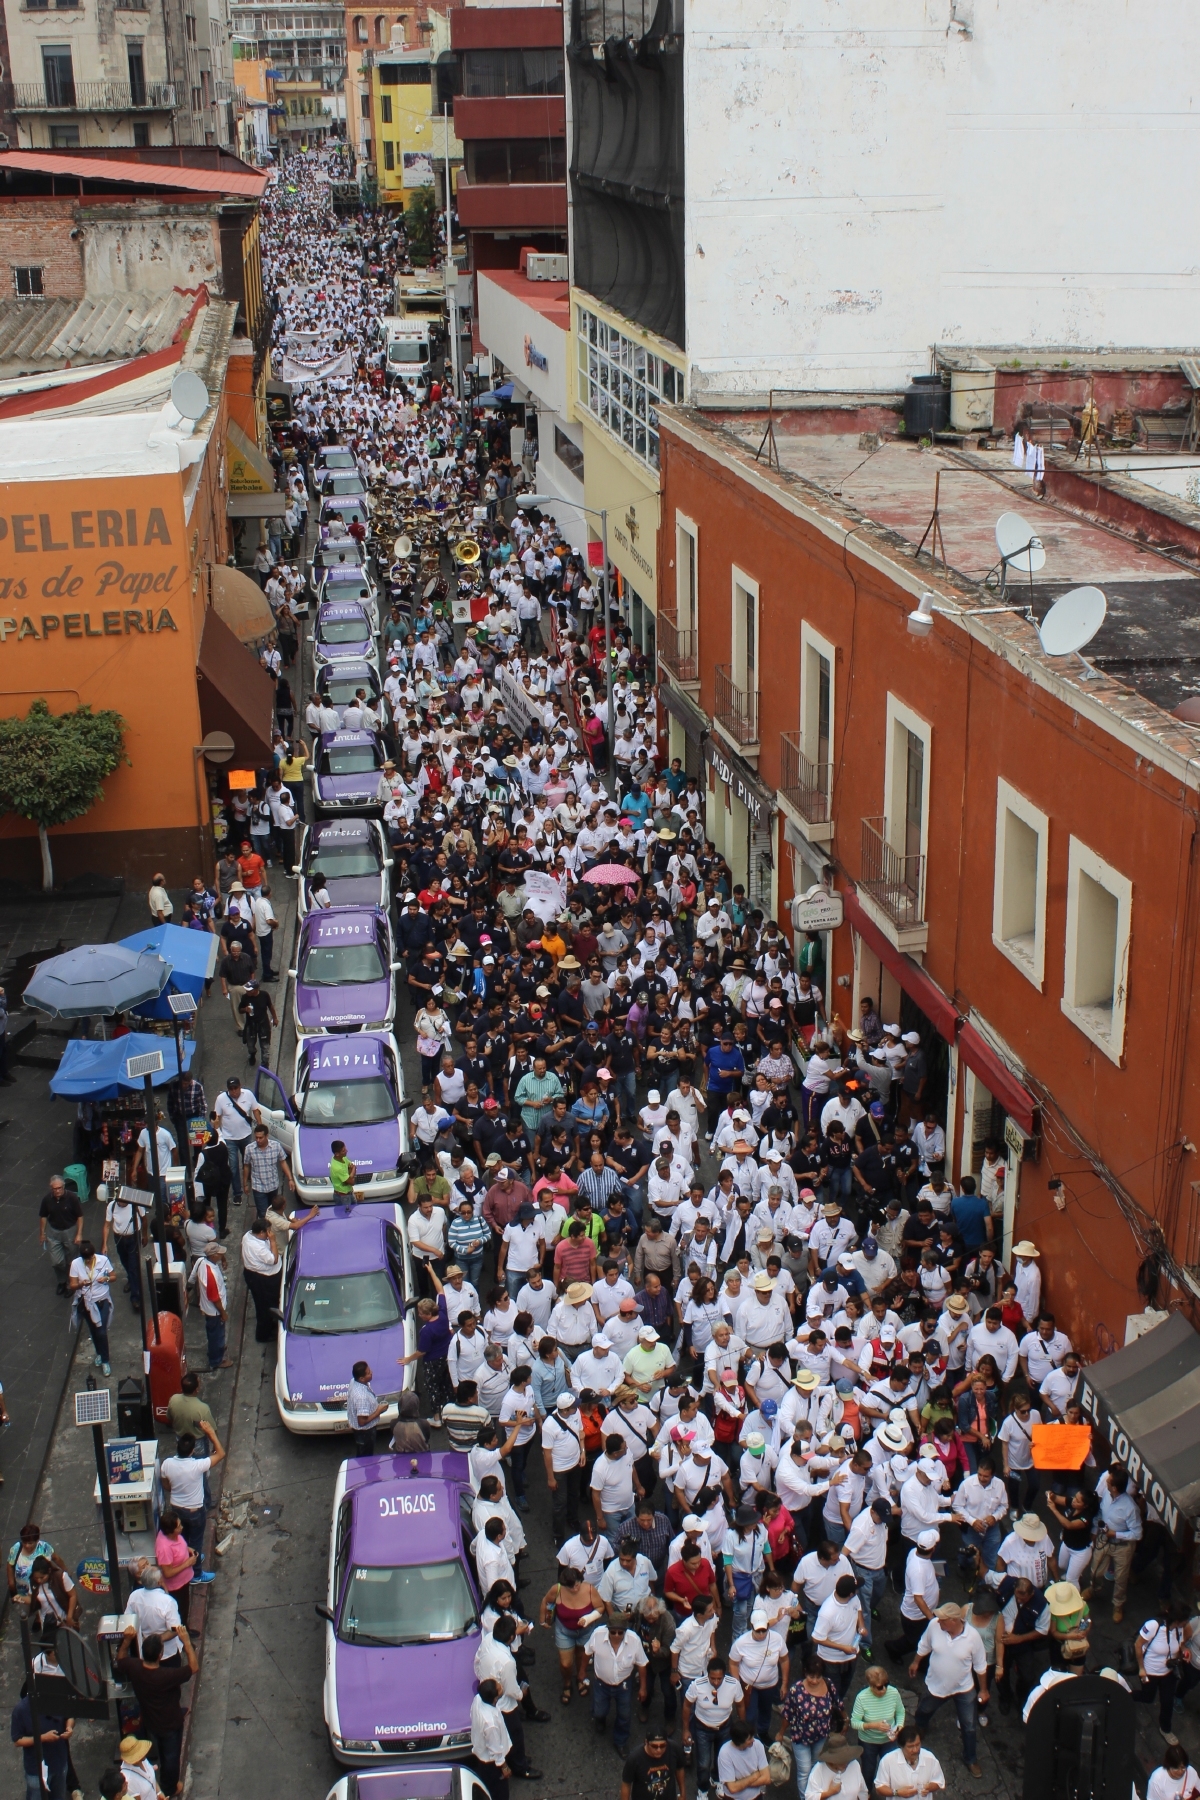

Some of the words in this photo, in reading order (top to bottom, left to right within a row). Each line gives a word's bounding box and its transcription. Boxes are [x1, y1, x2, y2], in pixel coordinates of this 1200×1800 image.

[41, 565, 84, 598] de
[95, 561, 178, 604] Papel
[0, 608, 178, 642] PAPELERIA
[738, 780, 761, 820] PINK
[1081, 1380, 1100, 1427] EL
[1107, 1414, 1178, 1535] TORTON
[380, 1493, 436, 1517] 5079LTG
[374, 1722, 448, 1735] Metropolitano
